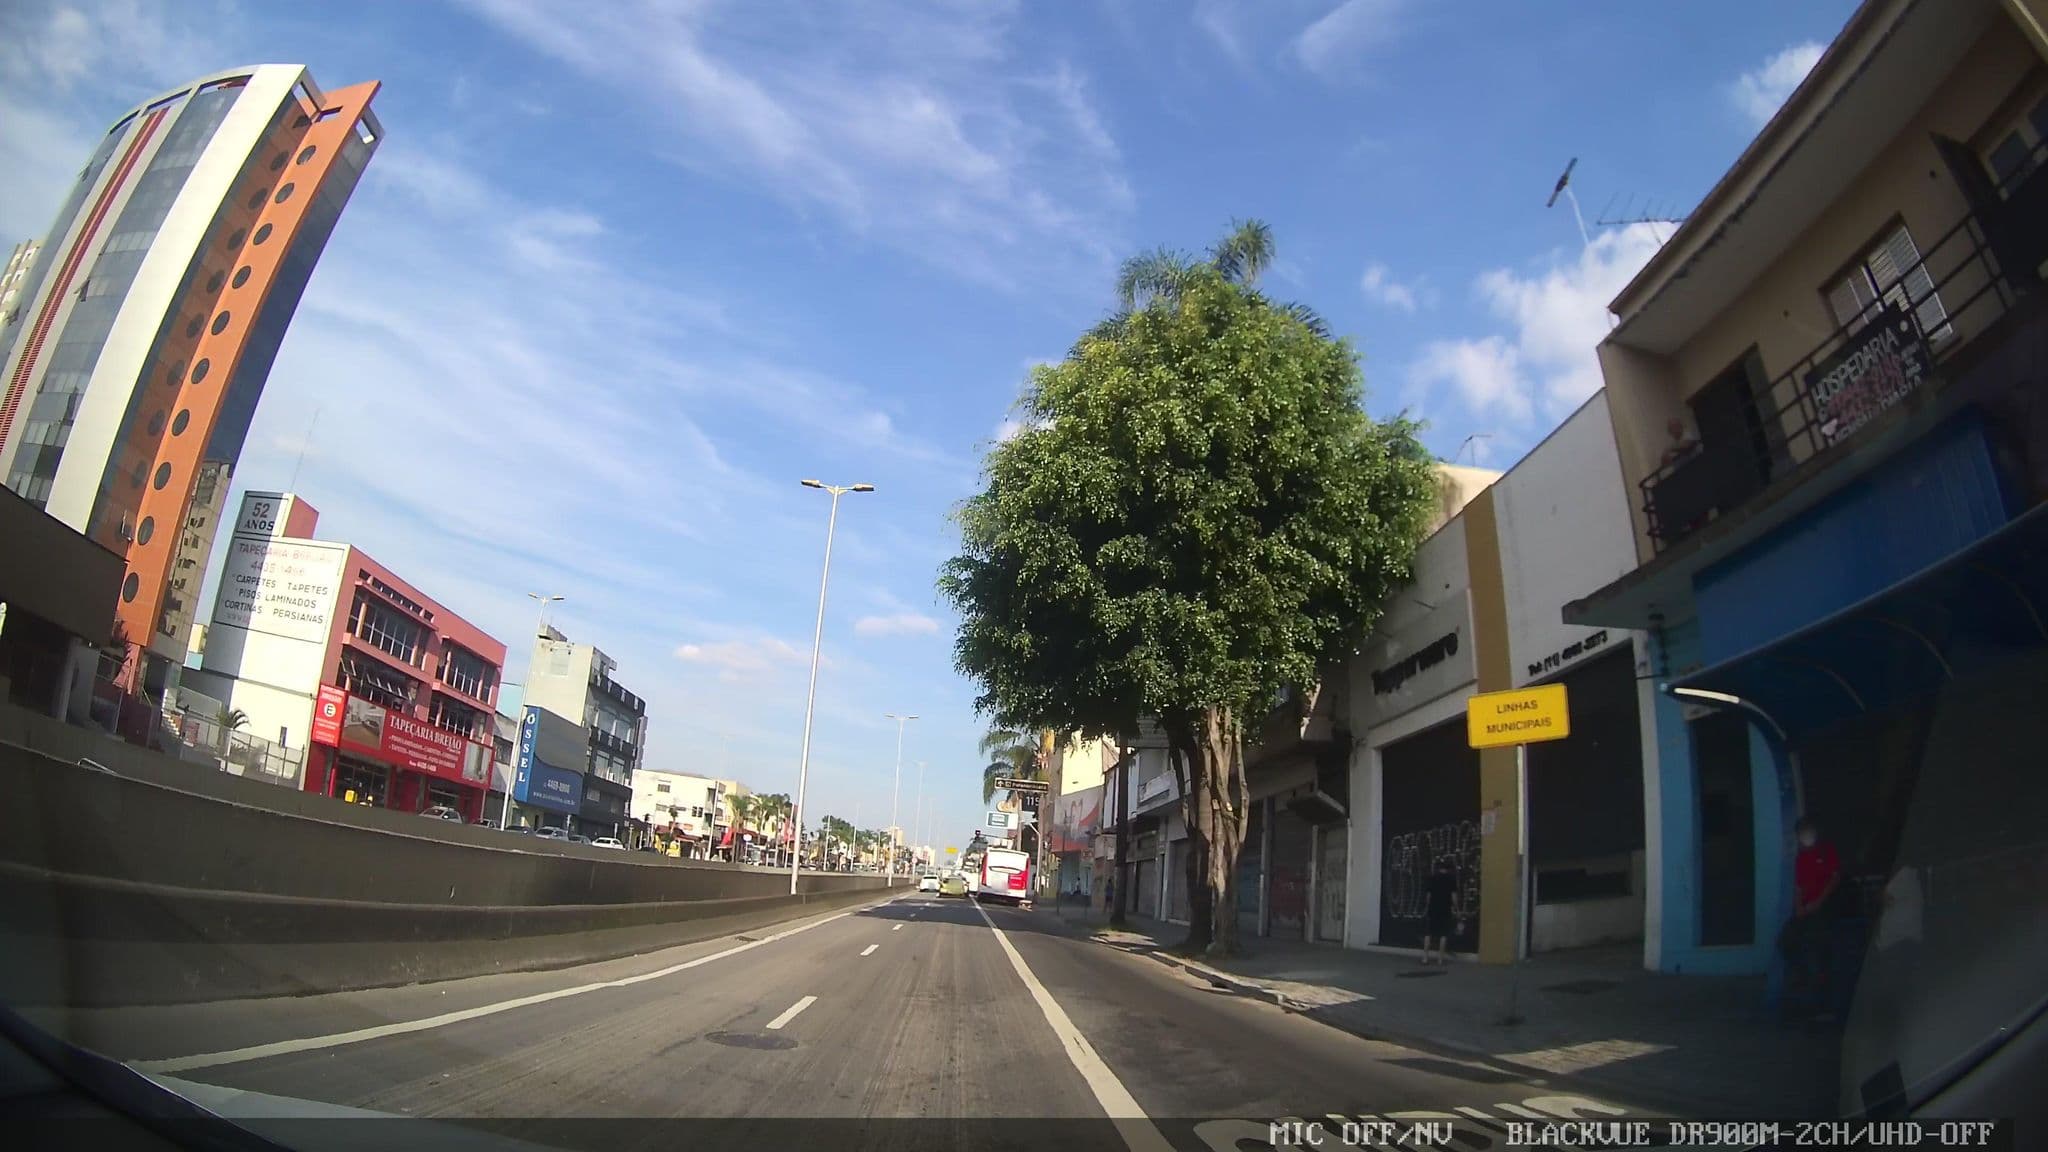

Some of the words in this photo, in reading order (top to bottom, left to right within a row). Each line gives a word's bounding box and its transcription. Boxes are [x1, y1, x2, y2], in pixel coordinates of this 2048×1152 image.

[1811, 327, 1900, 408] HOSPEDARIA
[252, 502, 270, 518] 52
[244, 520, 275, 531] ANOS
[236, 574, 277, 589] CARPETES
[287, 582, 328, 595] TAPETES
[238, 588, 261, 599] PISOS
[265, 594, 317, 609] LAMINADOS
[224, 599, 263, 614] CORTINAS
[273, 608, 324, 624] PERSIANAS
[1496, 700, 1539, 714] LINHAS
[390, 715, 434, 742] TAPEÇARIA
[1486, 716, 1553, 734] MUNICIPAIS
